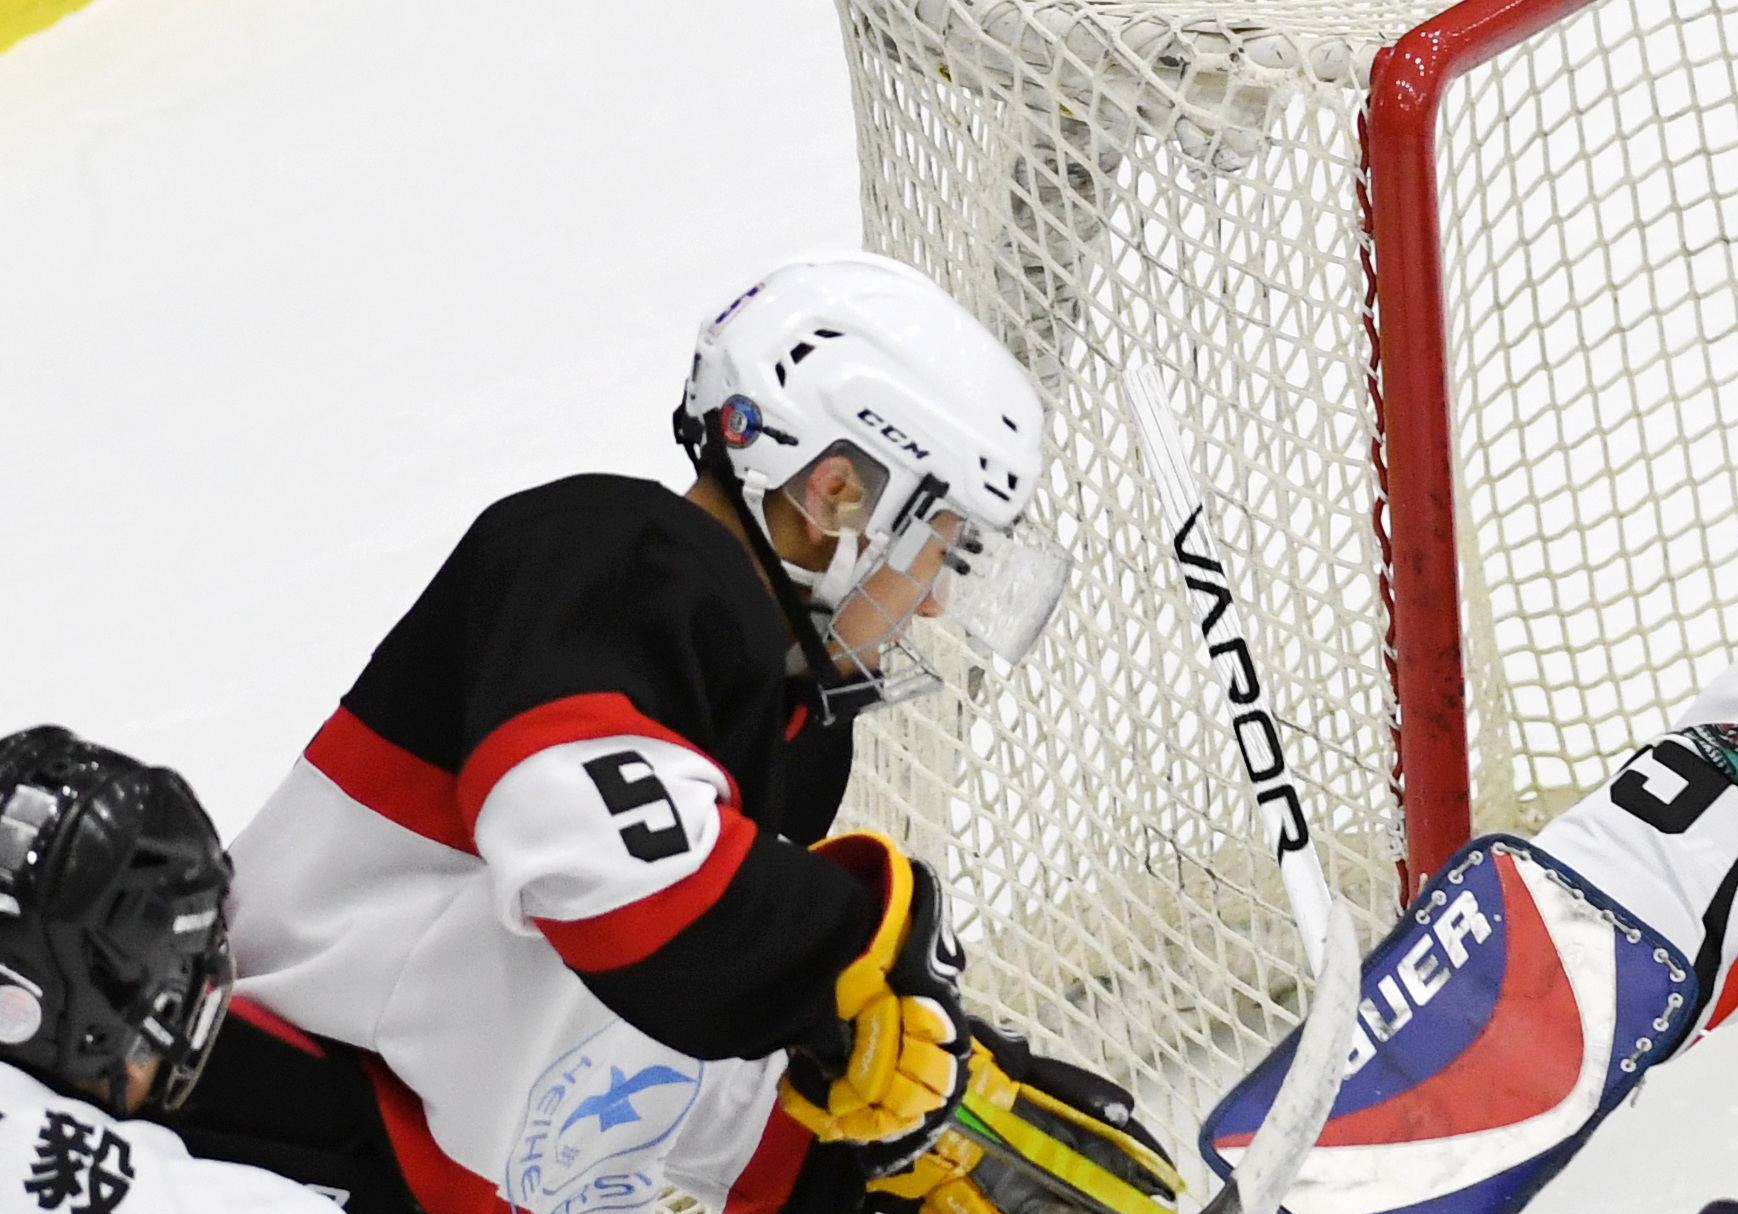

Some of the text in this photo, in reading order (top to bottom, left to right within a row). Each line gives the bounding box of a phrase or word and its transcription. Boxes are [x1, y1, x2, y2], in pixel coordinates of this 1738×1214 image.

[857, 408, 931, 460] CCM
[1173, 504, 1310, 865] VAPOR
[583, 750, 690, 863] 5
[1341, 890, 1494, 1081] AUER
[520, 1054, 593, 1202] HEIHE
